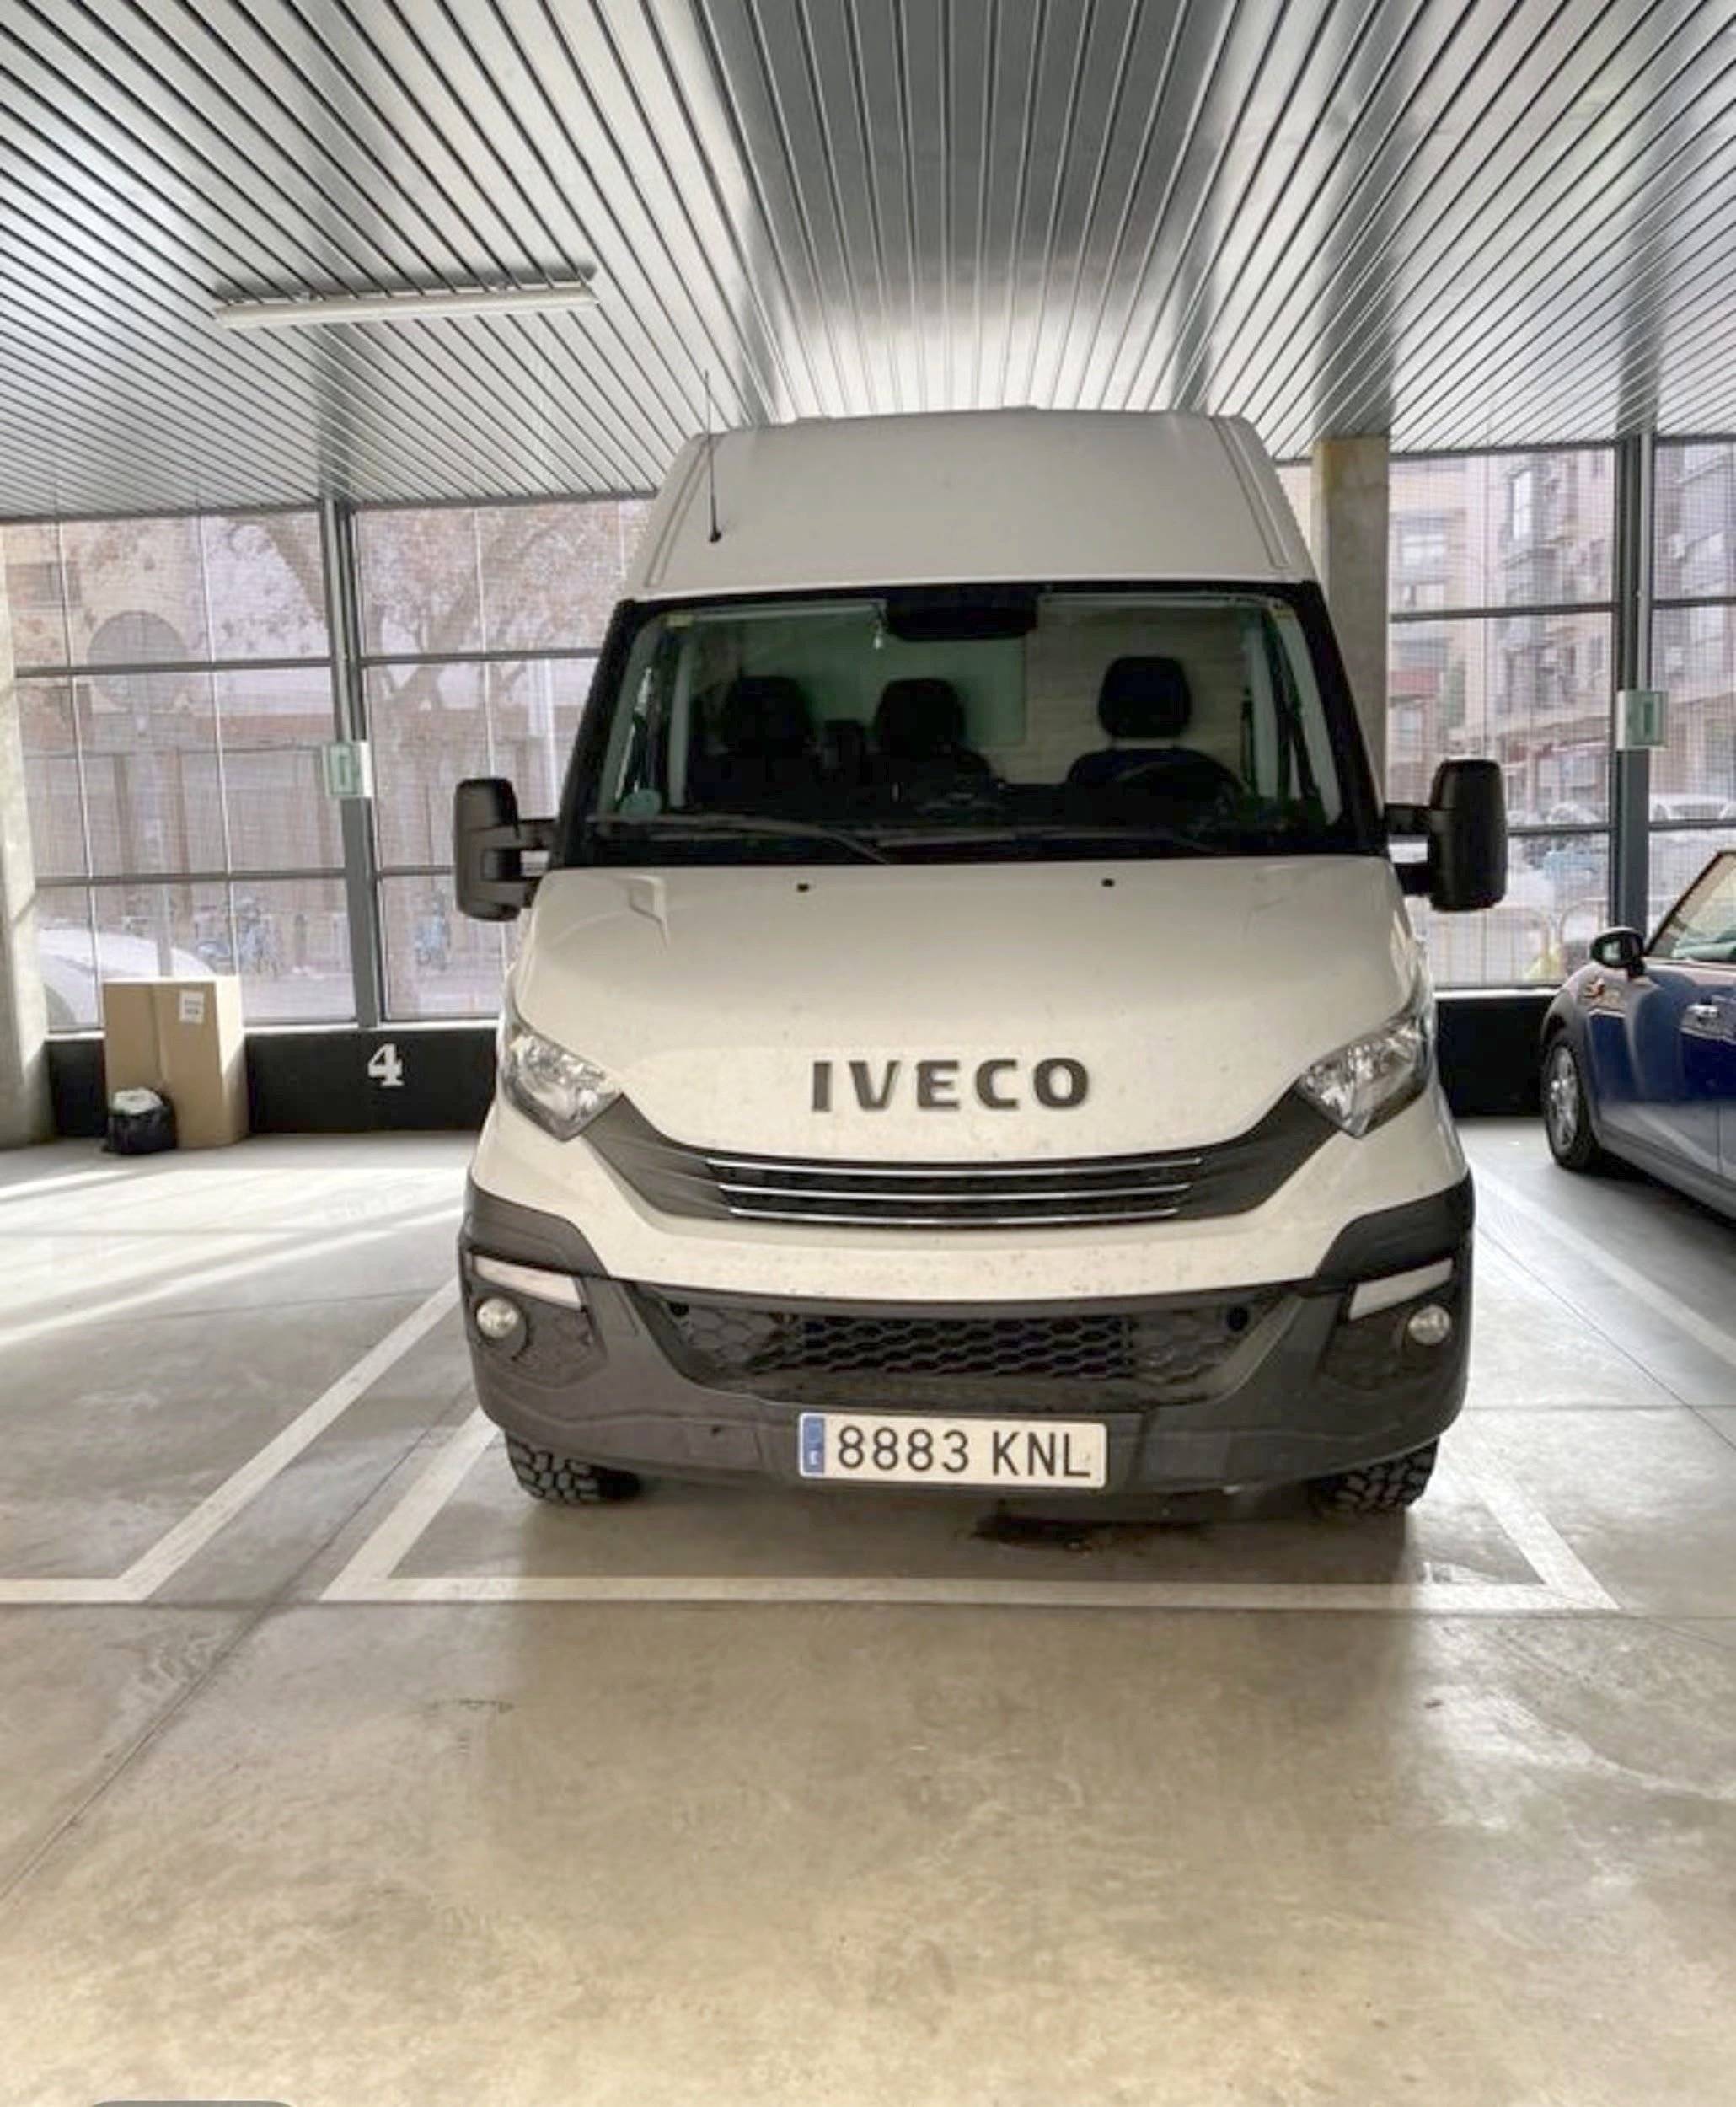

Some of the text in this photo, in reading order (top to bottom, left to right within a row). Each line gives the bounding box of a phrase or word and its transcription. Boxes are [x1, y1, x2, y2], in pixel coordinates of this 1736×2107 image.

[367, 1043, 404, 1086] 4
[812, 1057, 1090, 1112] IVECO
[838, 1425, 1090, 1478] 8883 KNL
